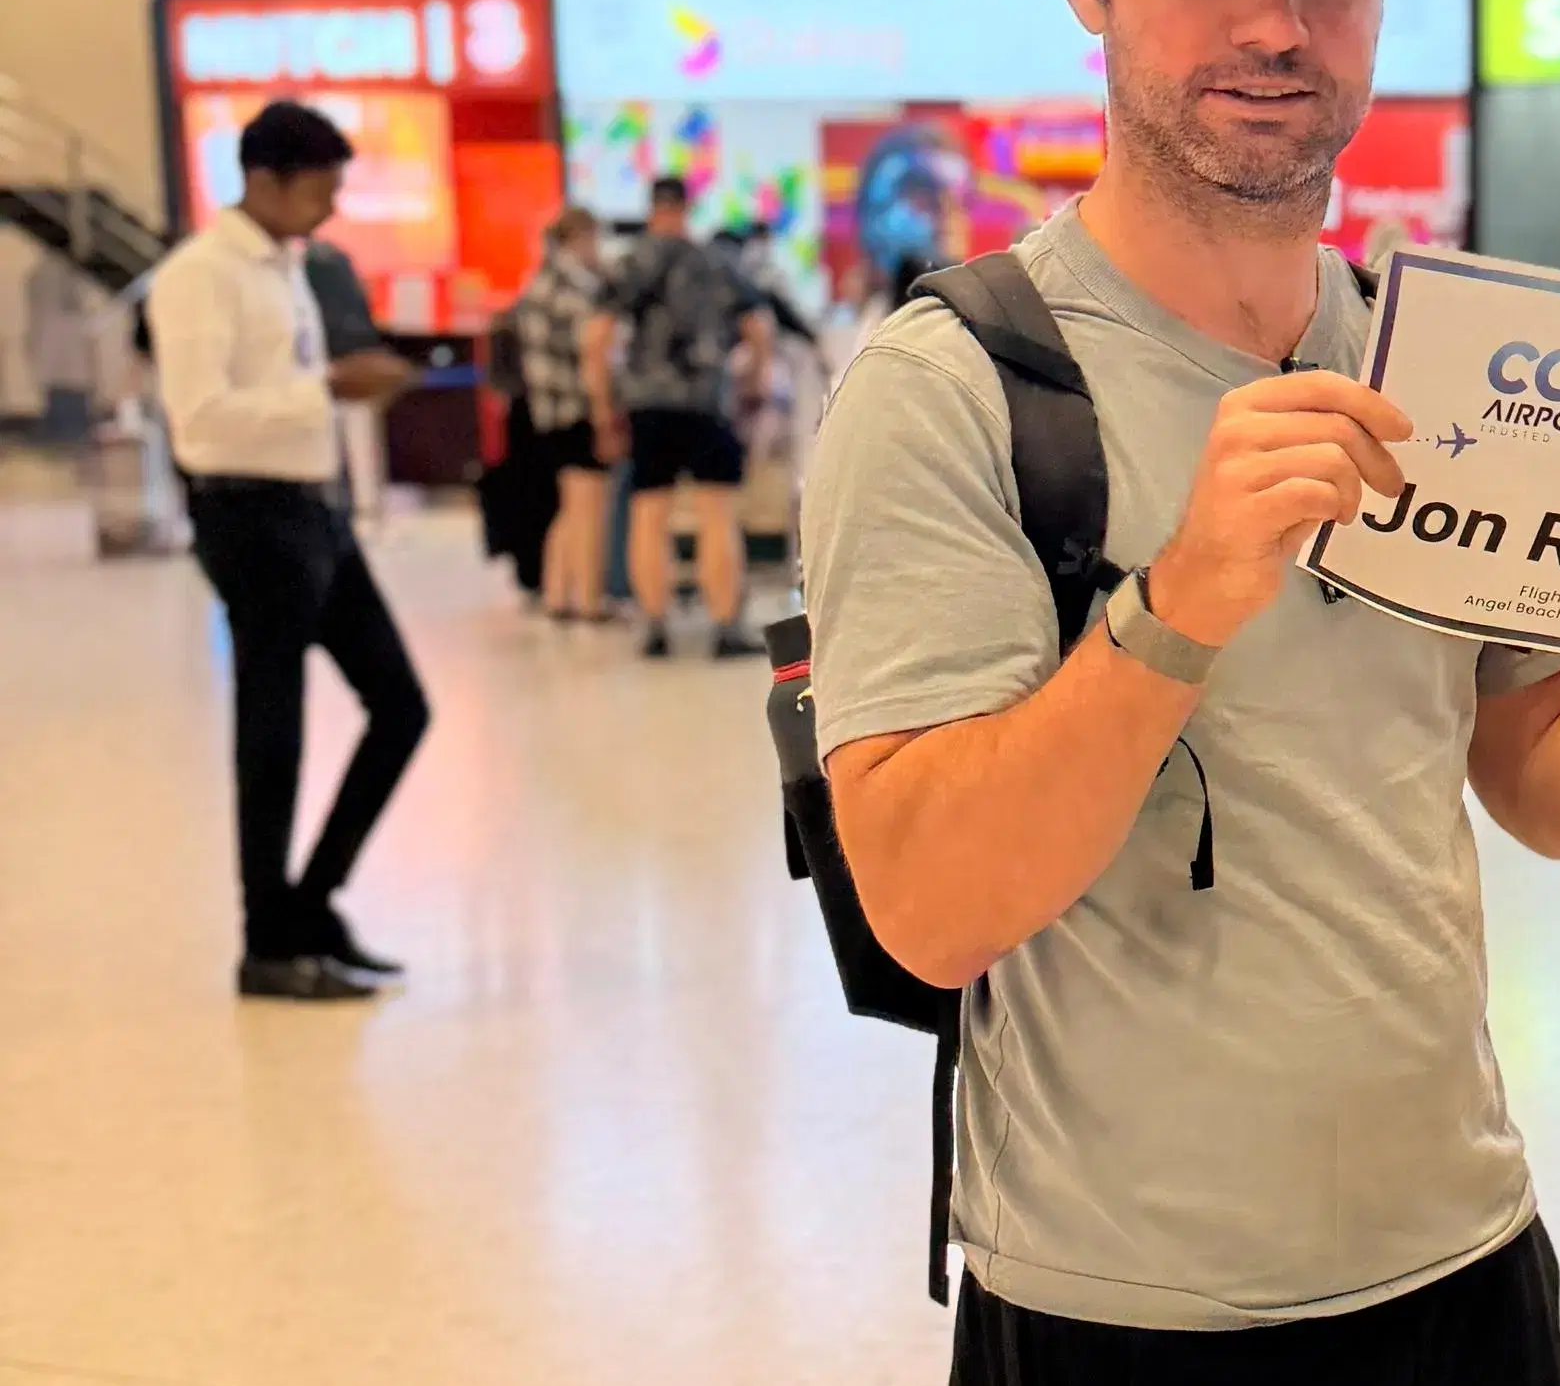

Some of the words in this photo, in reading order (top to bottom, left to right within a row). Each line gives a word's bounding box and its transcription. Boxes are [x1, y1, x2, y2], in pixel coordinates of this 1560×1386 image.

[1480, 423, 1550, 444] TRUSTED
[1361, 482, 1507, 553] Jon
[1464, 594, 1512, 612] Angel
